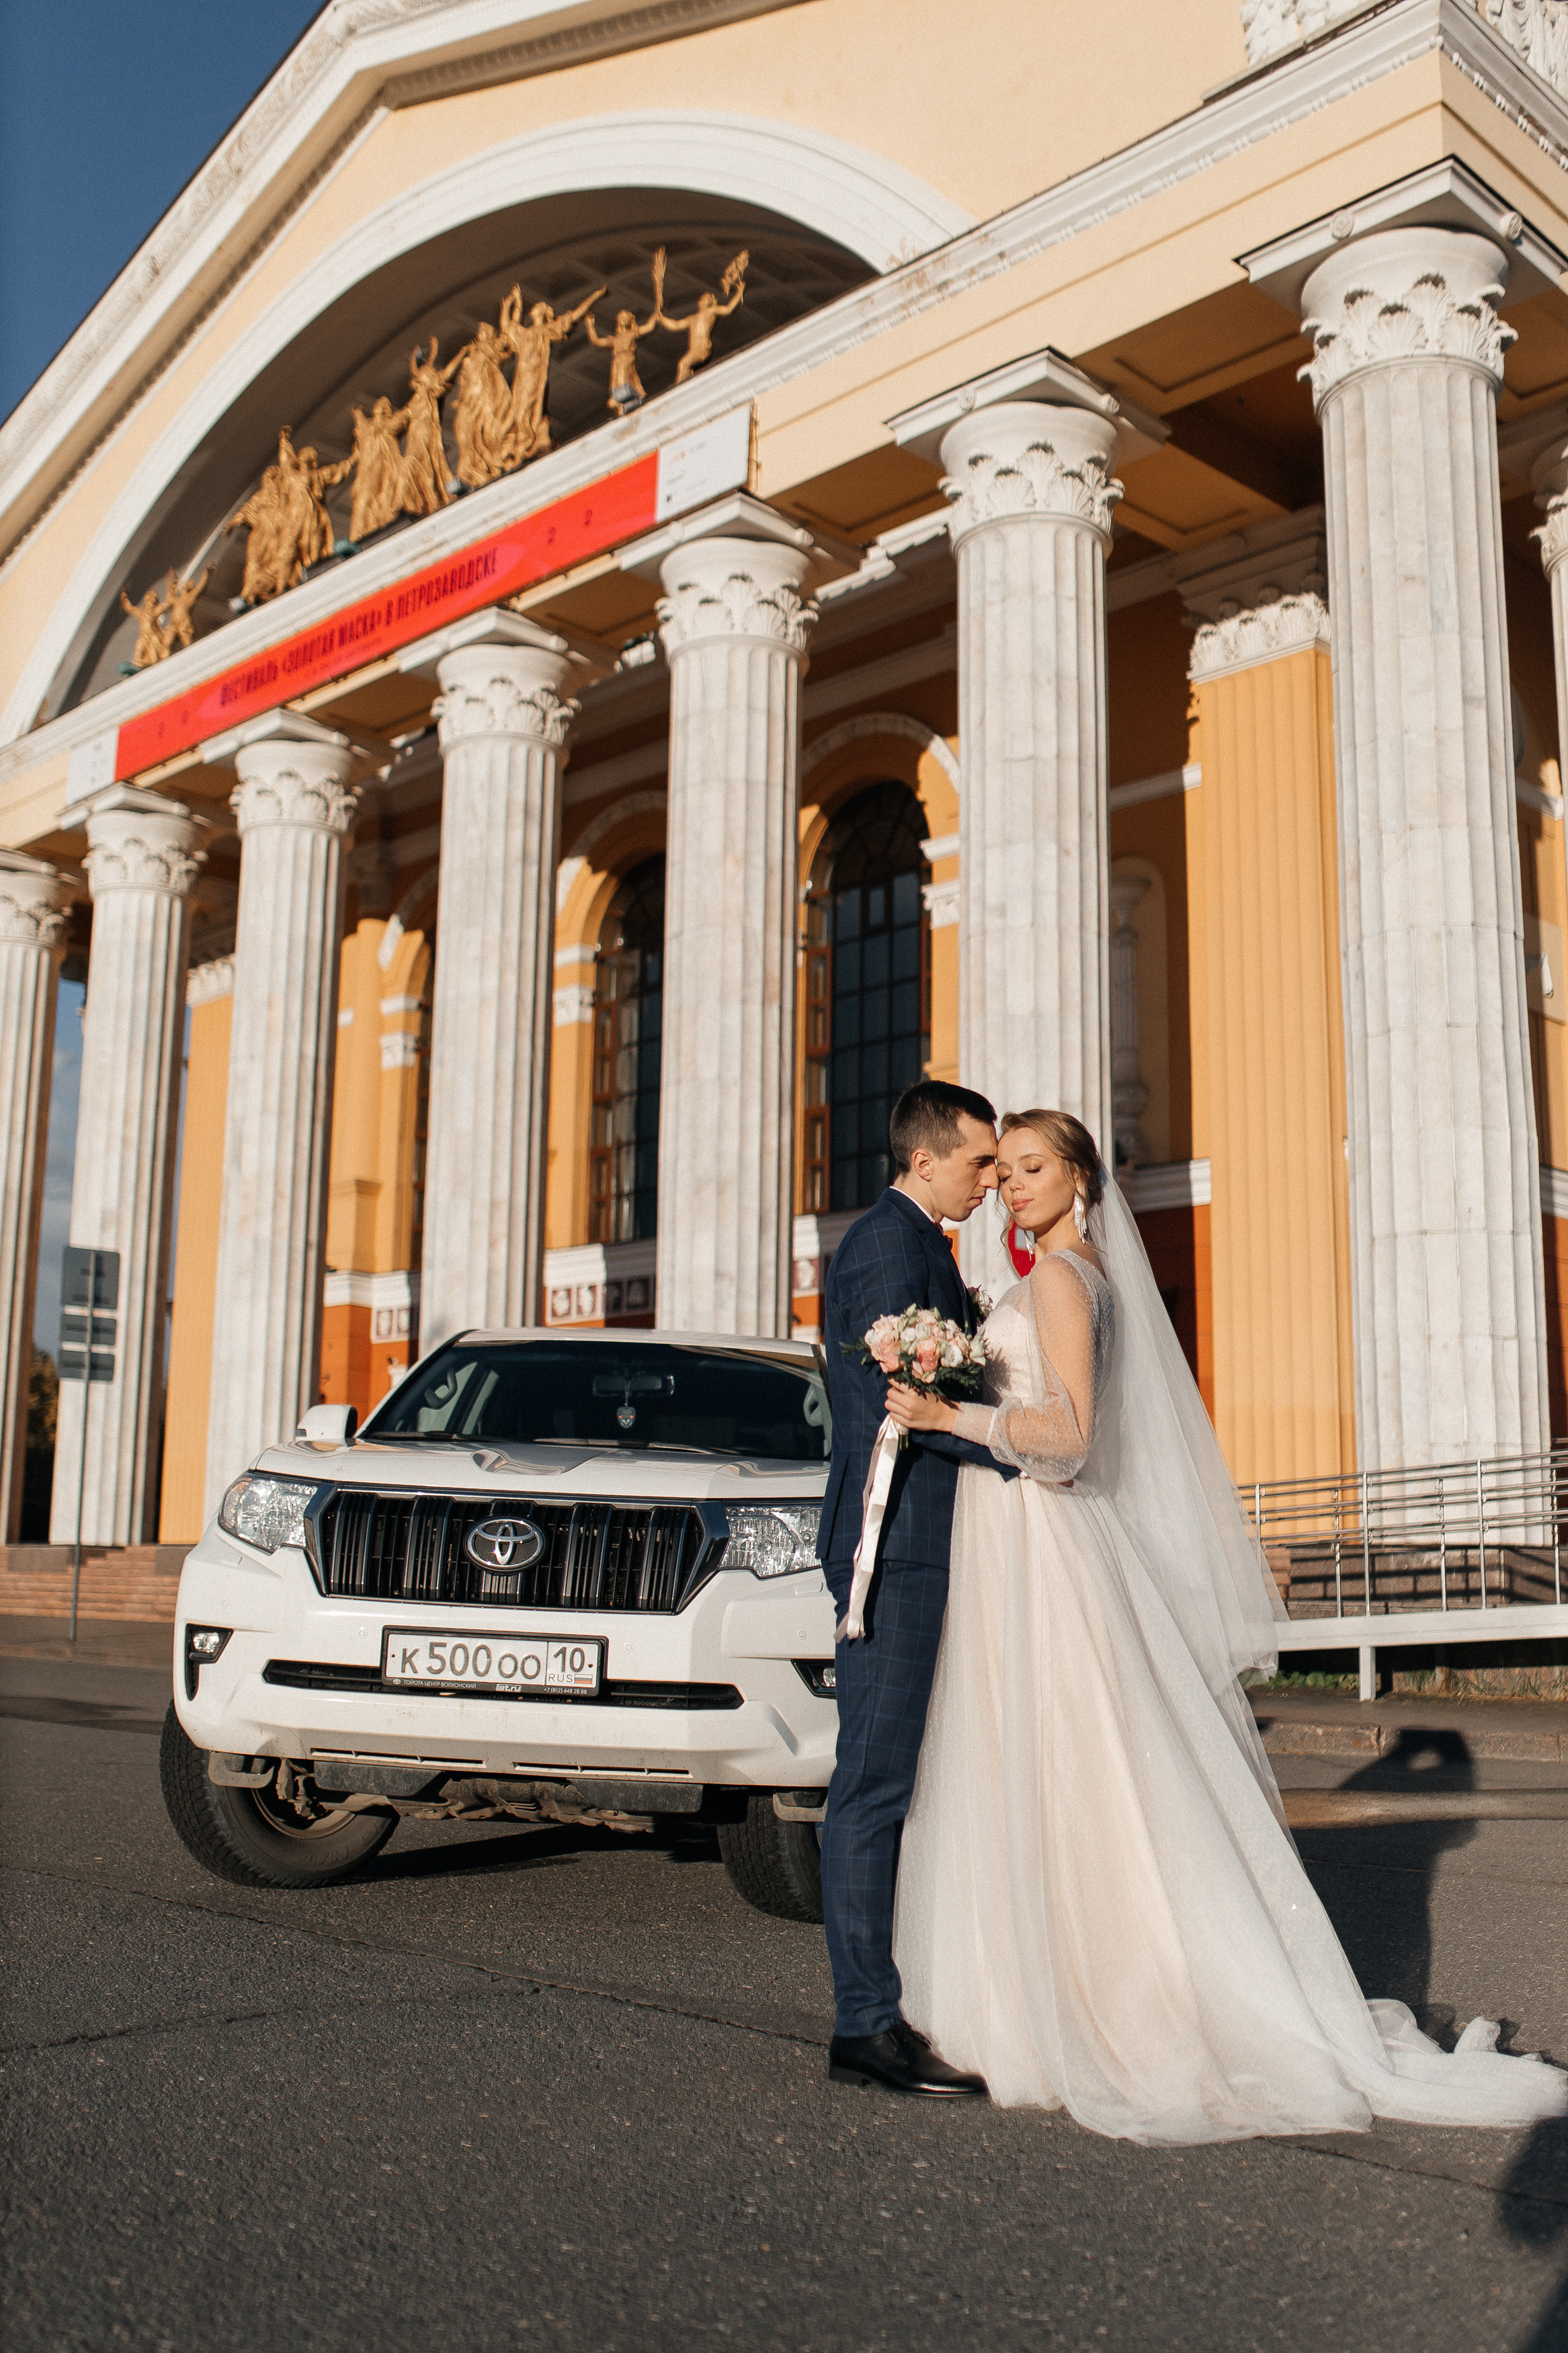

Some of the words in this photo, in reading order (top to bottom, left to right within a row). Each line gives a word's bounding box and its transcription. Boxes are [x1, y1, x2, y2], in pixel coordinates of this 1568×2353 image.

[386, 599, 394, 626] В
[397, 547, 498, 620] ПЕТРОЗАВОДСКЕ
[553, 1646, 585, 1672] 10
[548, 1673, 573, 1683] RUS
